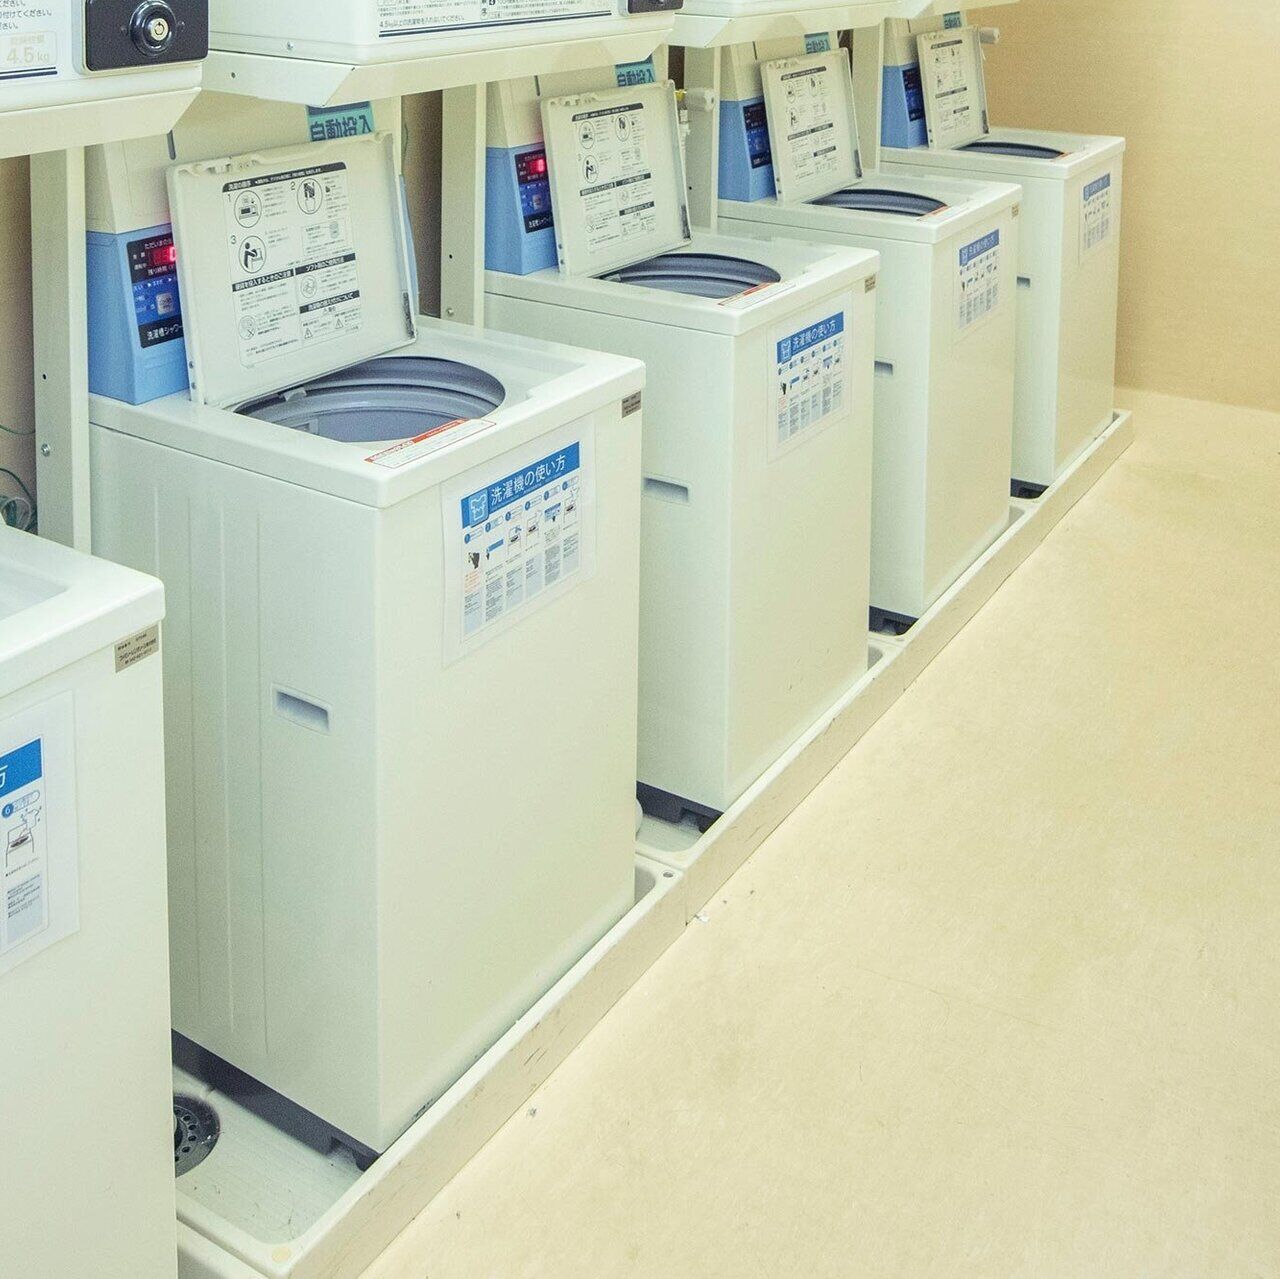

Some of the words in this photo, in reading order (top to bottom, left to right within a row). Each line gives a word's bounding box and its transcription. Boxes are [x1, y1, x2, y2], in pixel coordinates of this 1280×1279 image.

[230, 235, 237, 245] 3
[490, 454, 566, 506] 洗濯機の使い方
